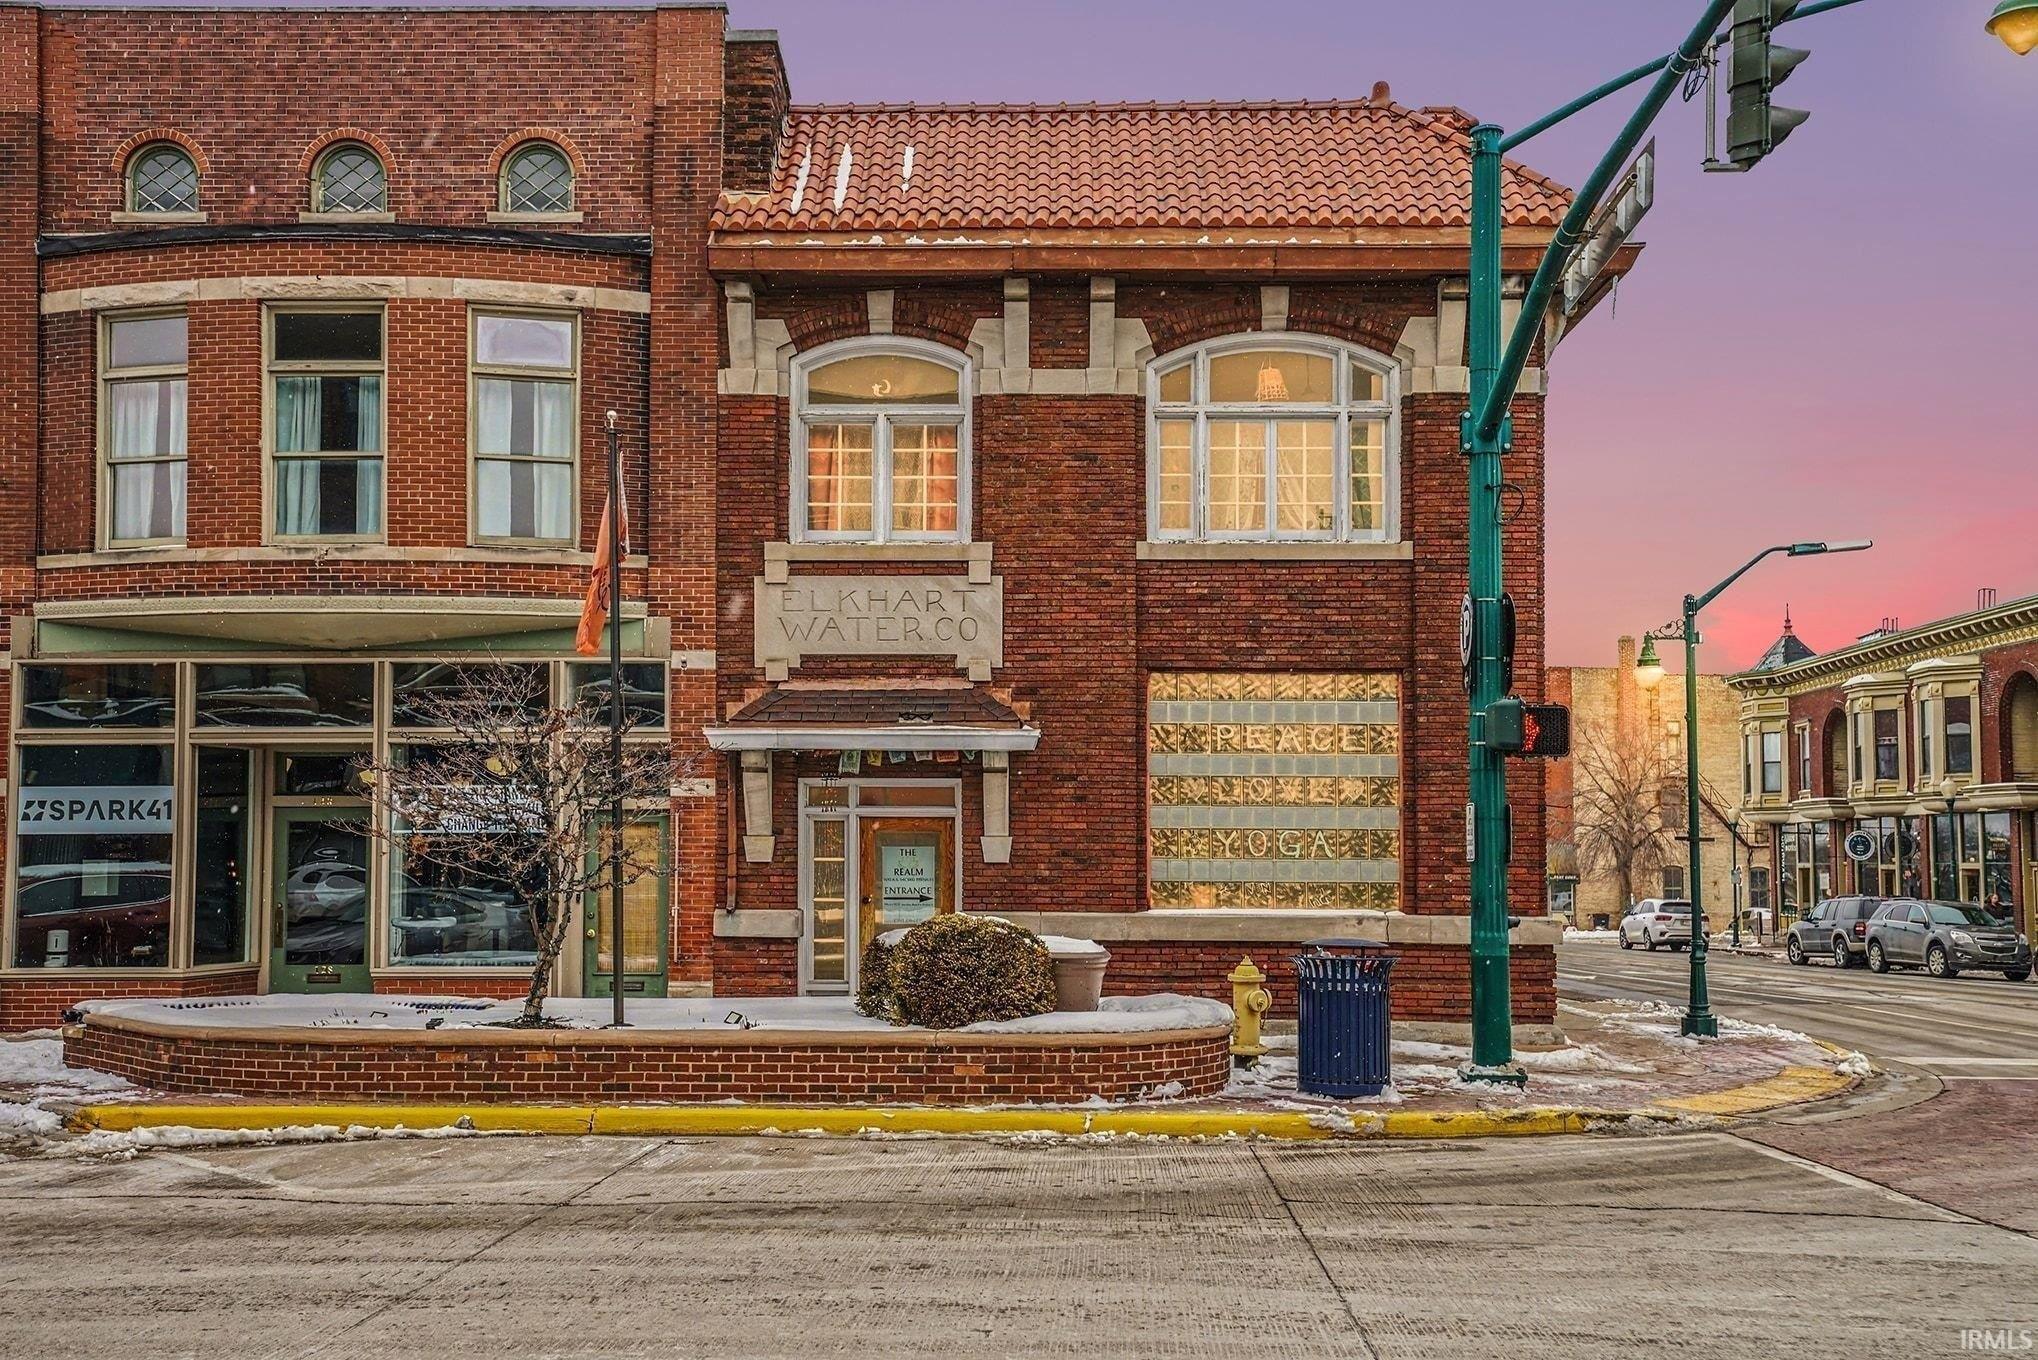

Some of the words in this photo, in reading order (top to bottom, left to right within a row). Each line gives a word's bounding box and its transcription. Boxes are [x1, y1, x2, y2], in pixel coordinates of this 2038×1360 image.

[781, 590, 977, 612] ELKHART
[1216, 724, 1367, 751] PEACE
[49, 799, 172, 821] SPARK41
[900, 849, 917, 857] THE
[1216, 830, 1334, 859] YOGA
[894, 868, 923, 876] REALM
[884, 886, 932, 895] ENTRANCE
